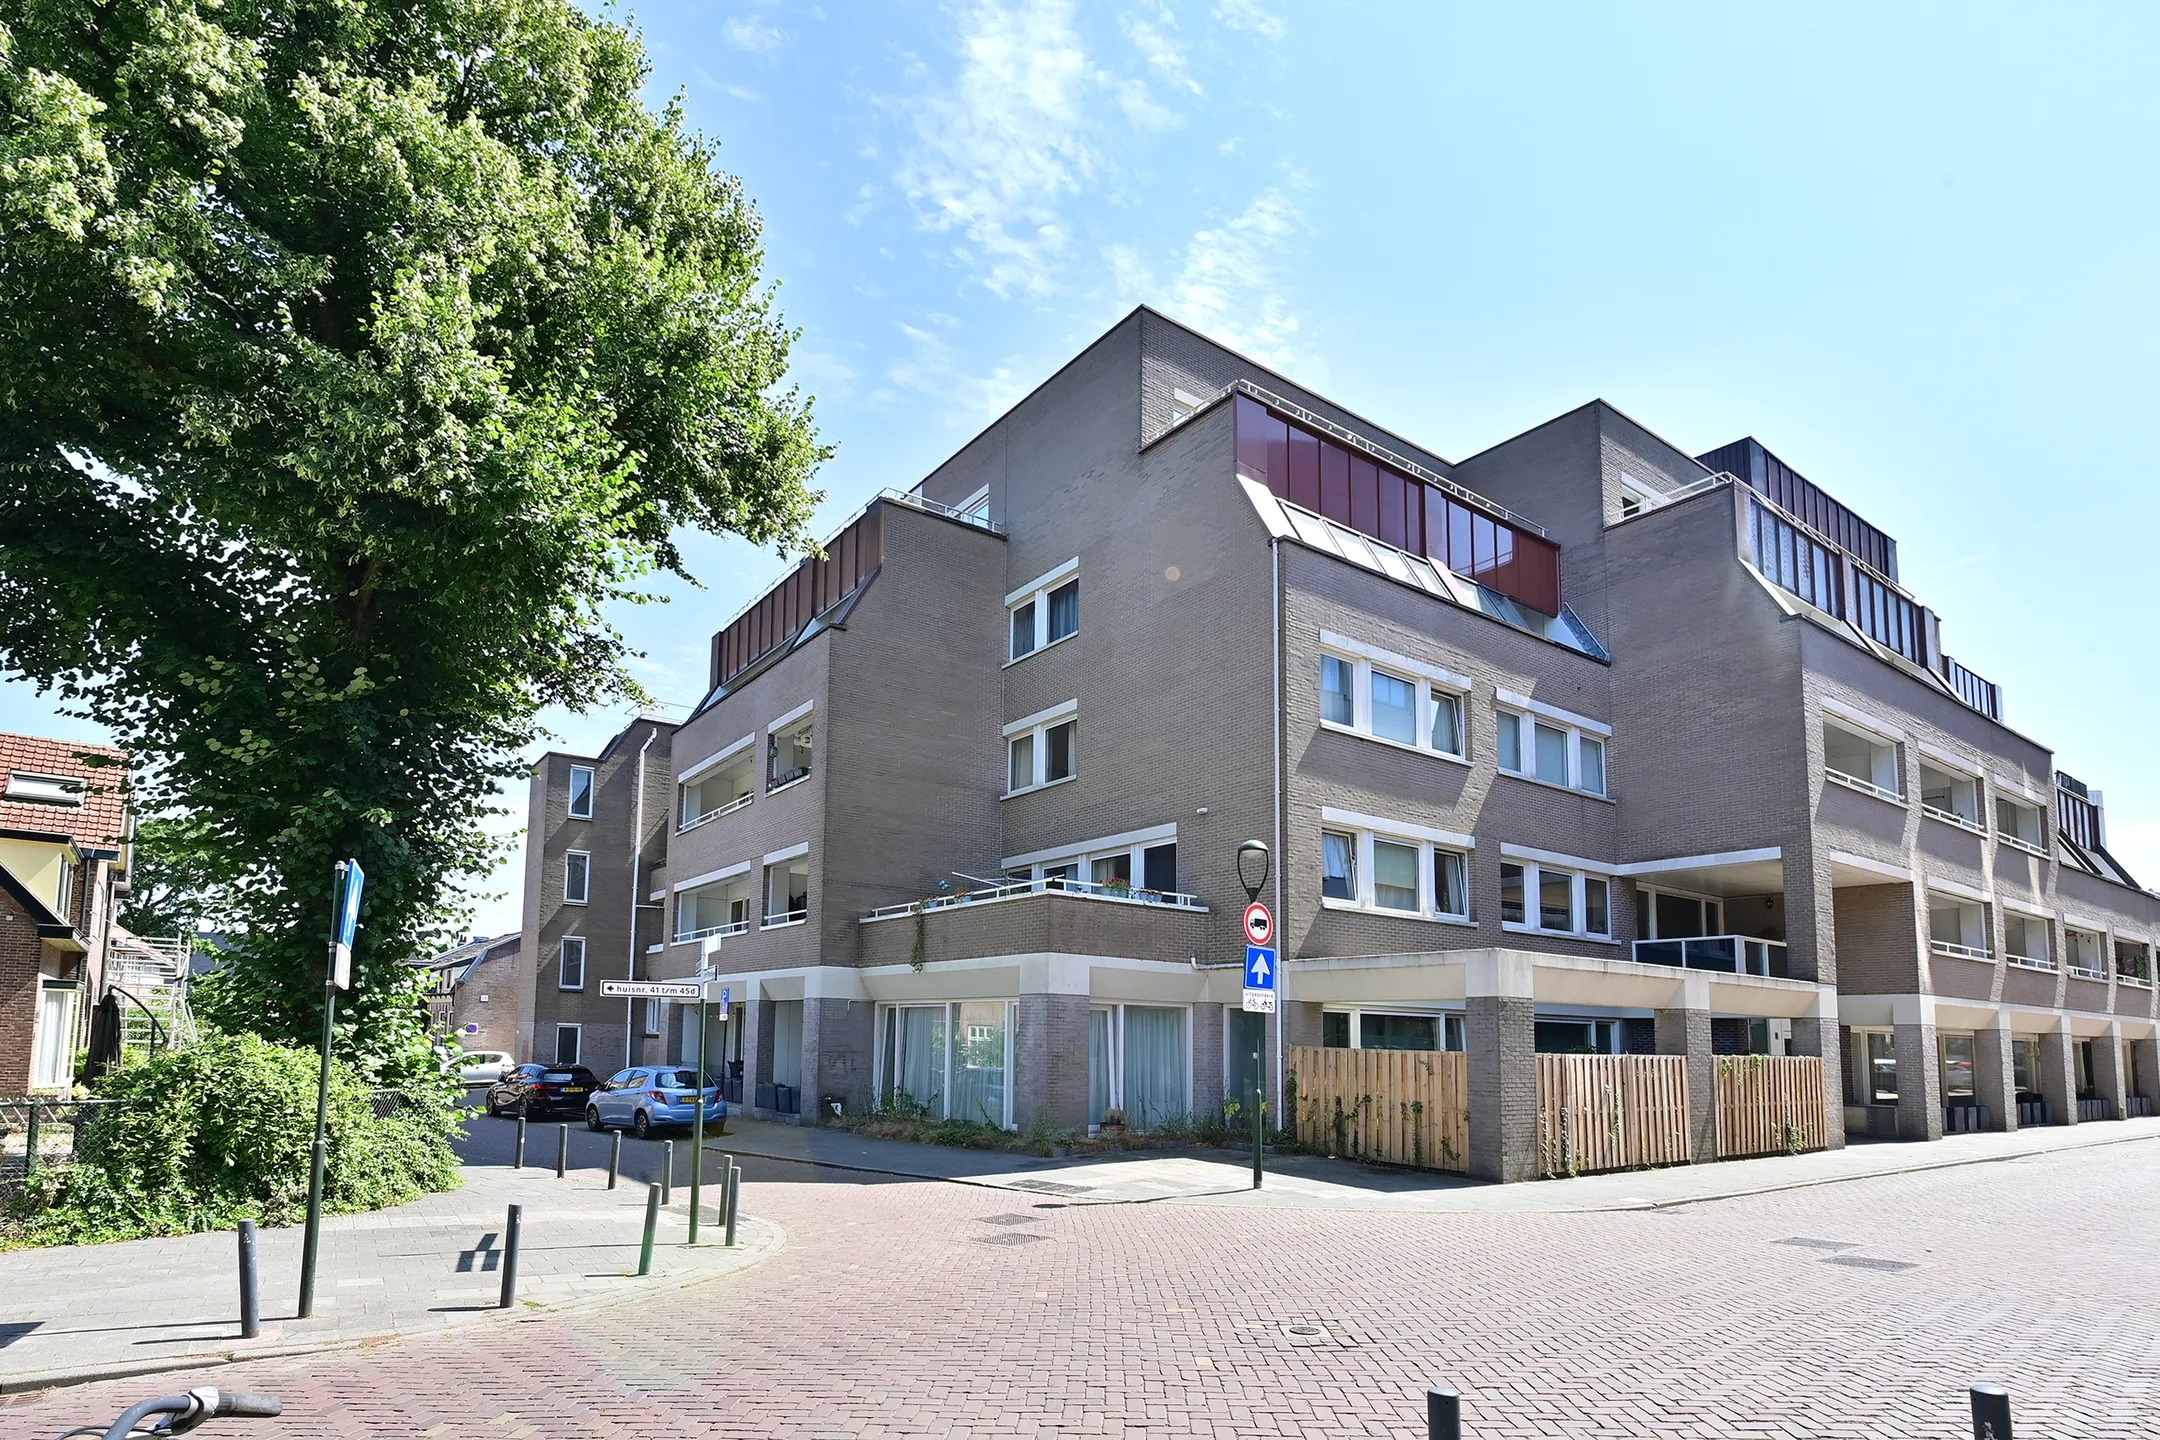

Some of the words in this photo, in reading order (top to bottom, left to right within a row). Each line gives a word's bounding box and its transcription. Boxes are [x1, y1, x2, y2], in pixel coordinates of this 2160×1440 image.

[616, 985, 648, 994] huisnr.
[650, 986, 659, 994] 41
[679, 987, 695, 995] 45d
